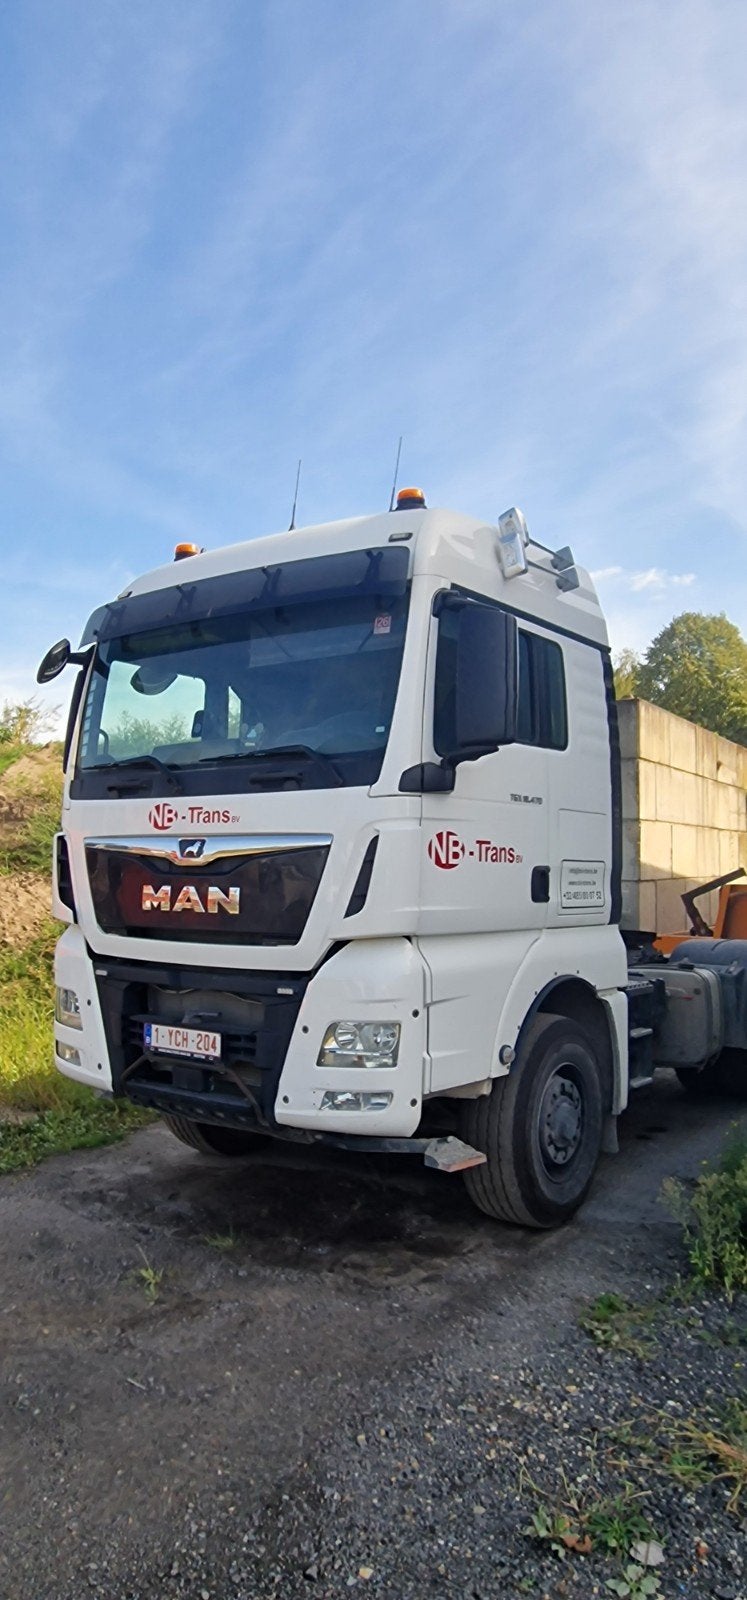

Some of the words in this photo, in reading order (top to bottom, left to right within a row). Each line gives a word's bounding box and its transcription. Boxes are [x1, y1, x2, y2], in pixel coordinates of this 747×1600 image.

[149, 803, 178, 830] NB
[428, 831, 465, 869] NB
[141, 884, 241, 915] MAN
